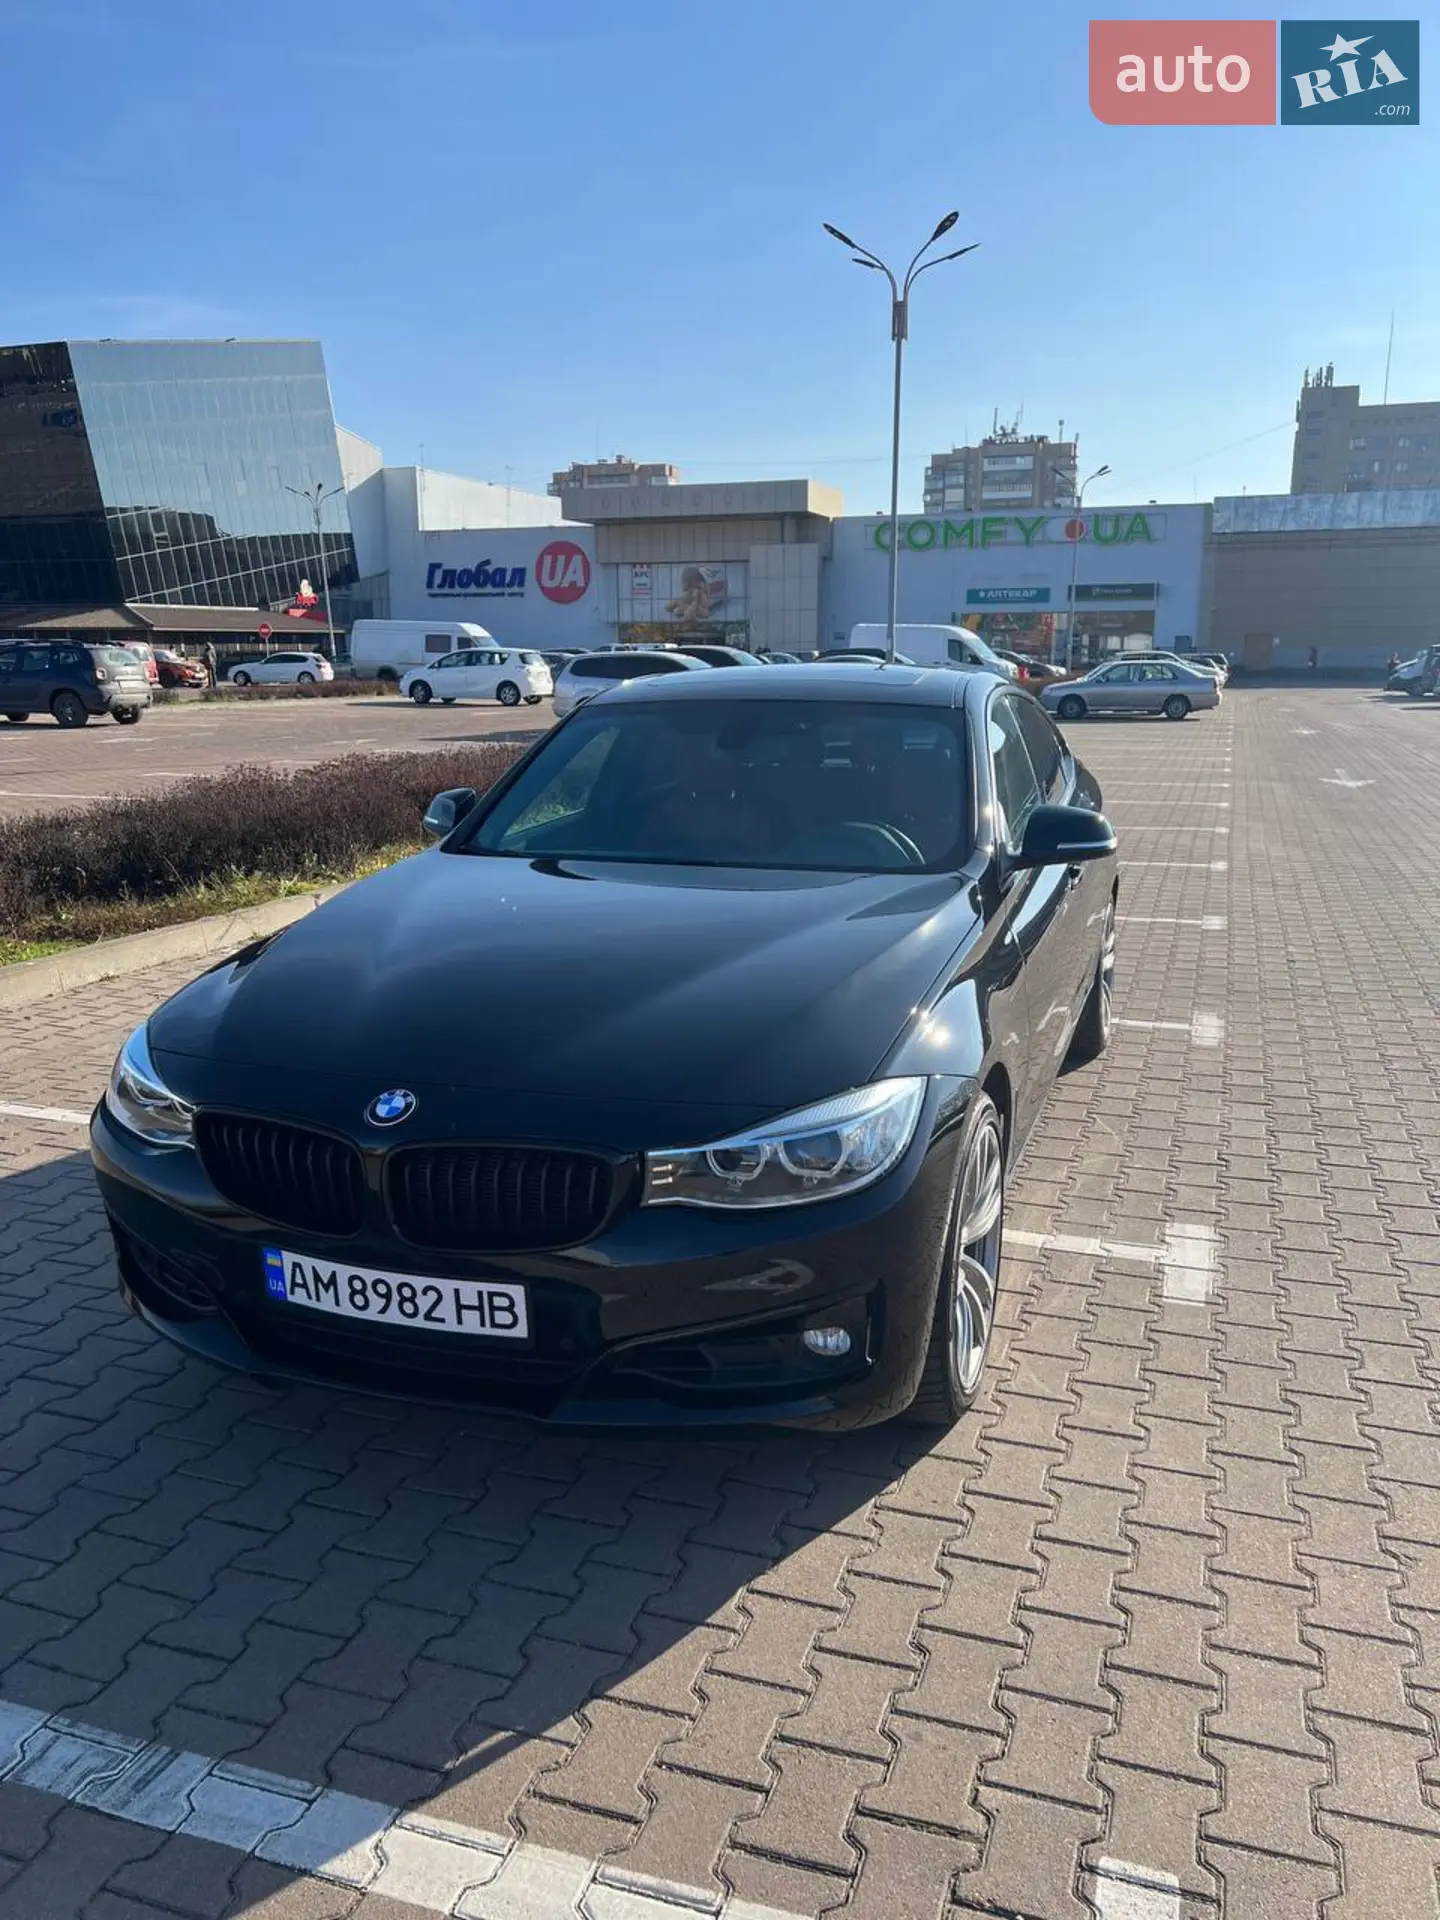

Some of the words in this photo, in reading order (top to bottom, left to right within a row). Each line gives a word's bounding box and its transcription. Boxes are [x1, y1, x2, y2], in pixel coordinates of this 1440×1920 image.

[874, 515, 1049, 552] COMFY
[1091, 511, 1153, 546] UA
[426, 558, 527, 589] Глобал
[540, 554, 585, 588] UA
[269, 1278, 285, 1294] UA
